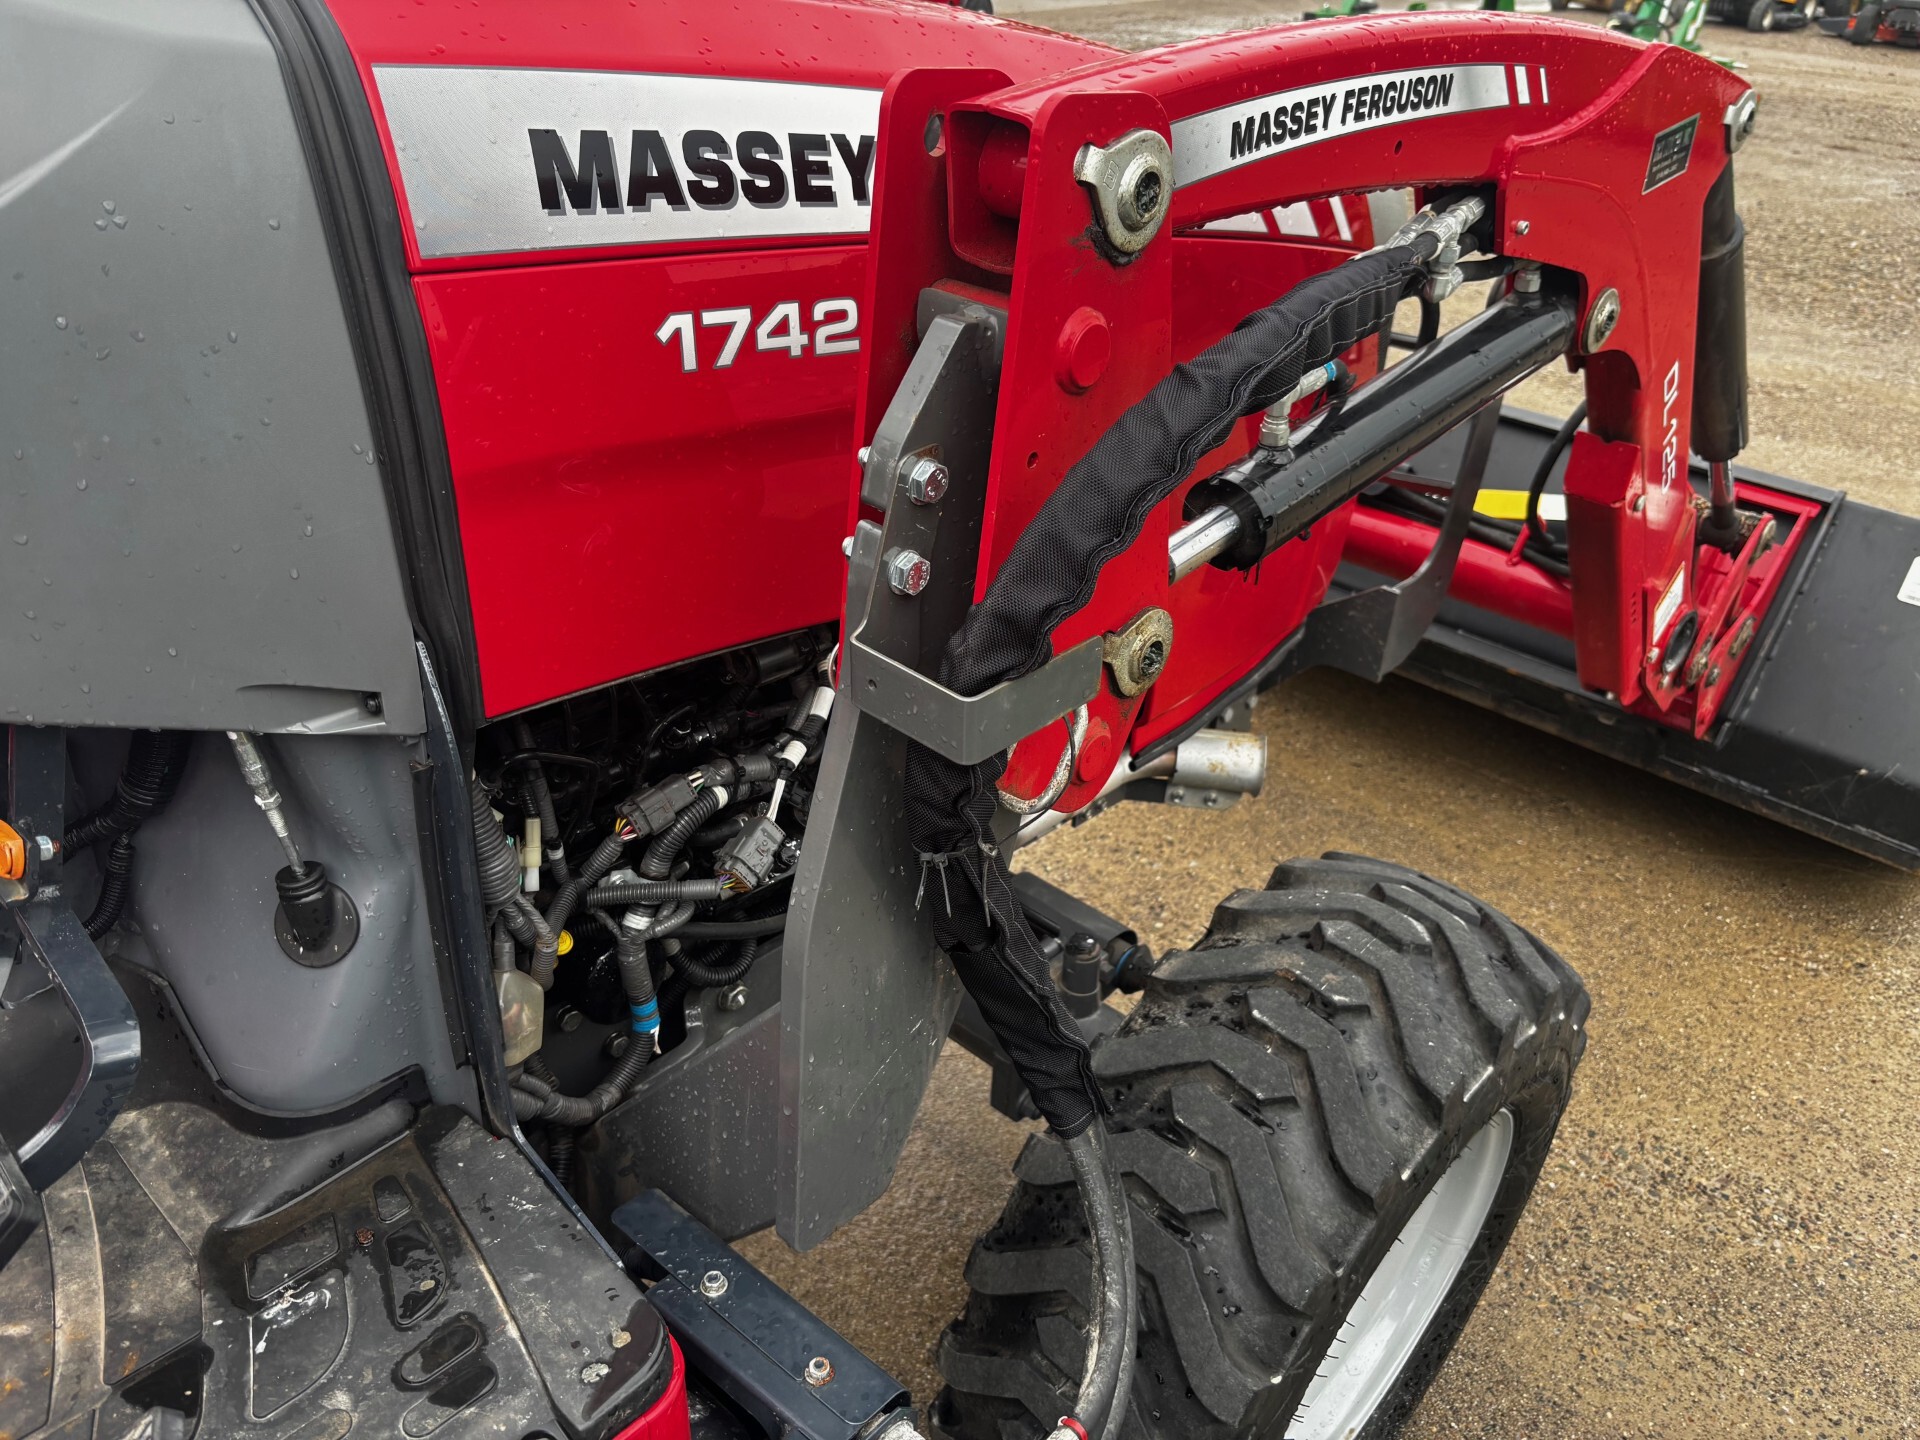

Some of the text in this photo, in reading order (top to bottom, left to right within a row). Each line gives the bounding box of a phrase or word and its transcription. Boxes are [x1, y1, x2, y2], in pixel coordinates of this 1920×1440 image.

[1230, 73, 1454, 159] MASSEY FERGUSON
[528, 128, 876, 216] MASSEY
[655, 297, 861, 373] 1742
[1661, 360, 1680, 494] DL125
